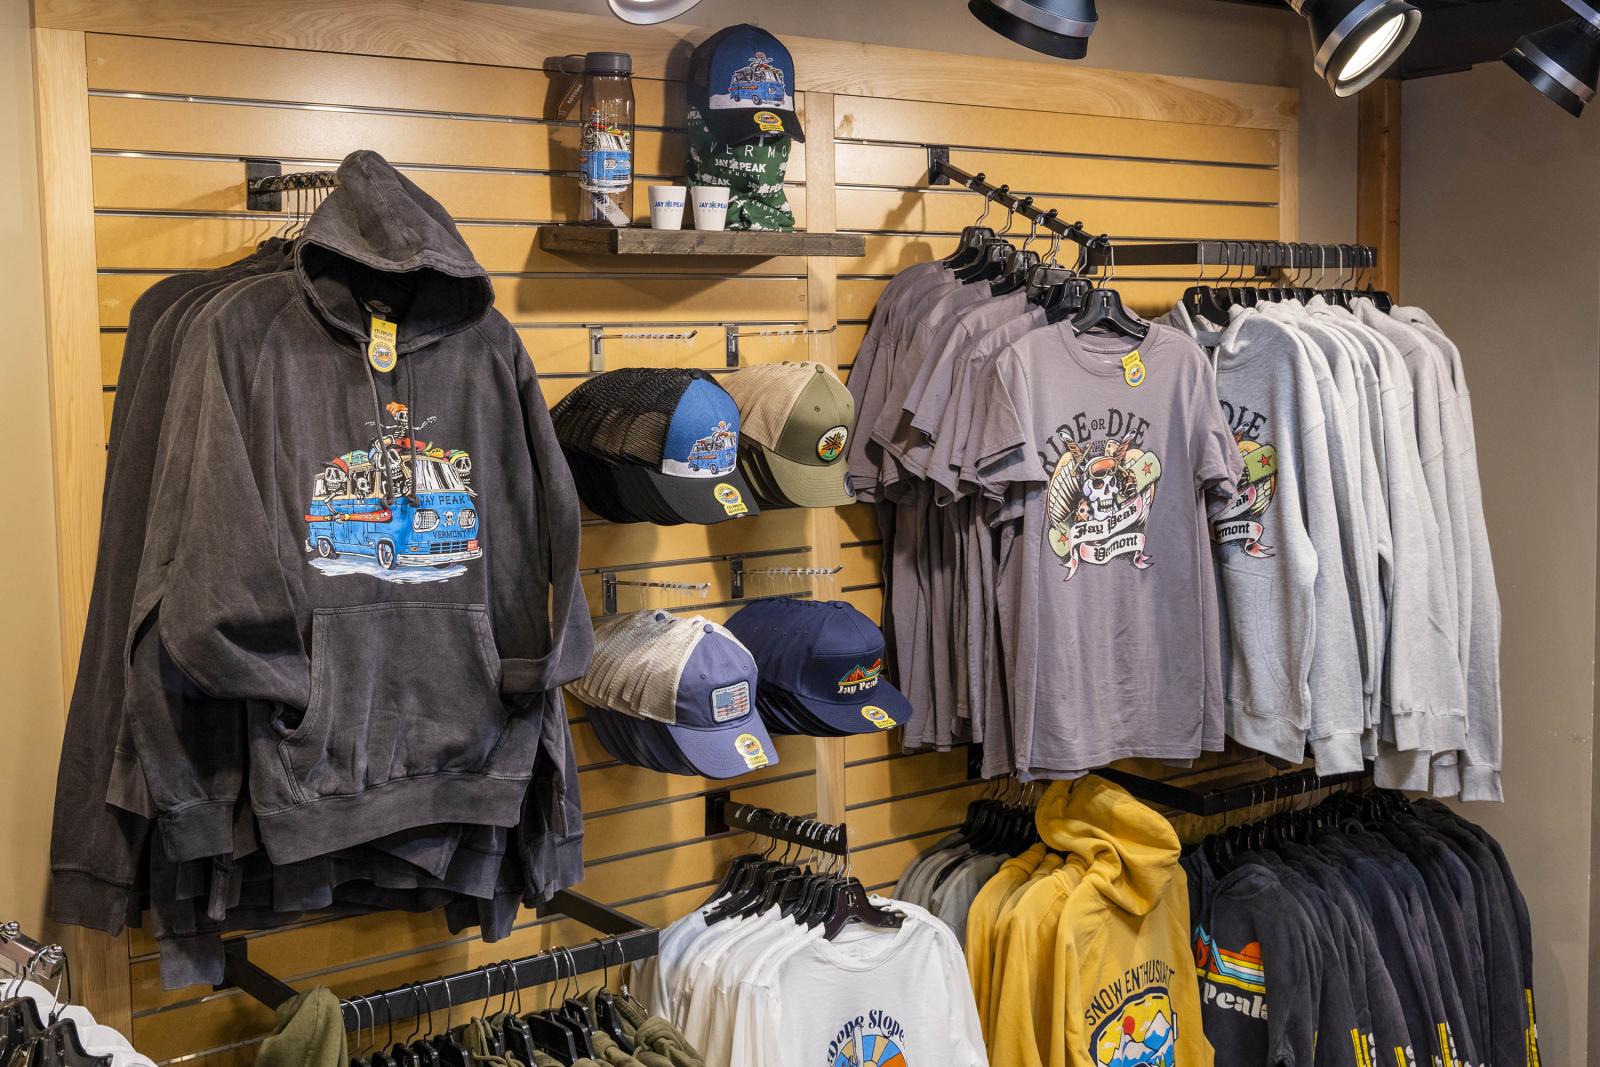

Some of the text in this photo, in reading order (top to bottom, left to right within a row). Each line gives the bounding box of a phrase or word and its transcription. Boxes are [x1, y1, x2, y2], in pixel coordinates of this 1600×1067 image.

[711, 141, 791, 158] VERMO
[714, 158, 767, 173] JAY PEAK
[1037, 408, 1151, 477] RIDE OR DIE
[420, 495, 466, 506] JAY PEAK
[1073, 505, 1137, 539] Jay Peak
[432, 530, 466, 539] VERMONT
[1093, 535, 1138, 561] Vermont
[837, 676, 878, 695] Jay Peak
[1085, 978, 1123, 1027] SNOW
[827, 1015, 865, 1064] Dope
